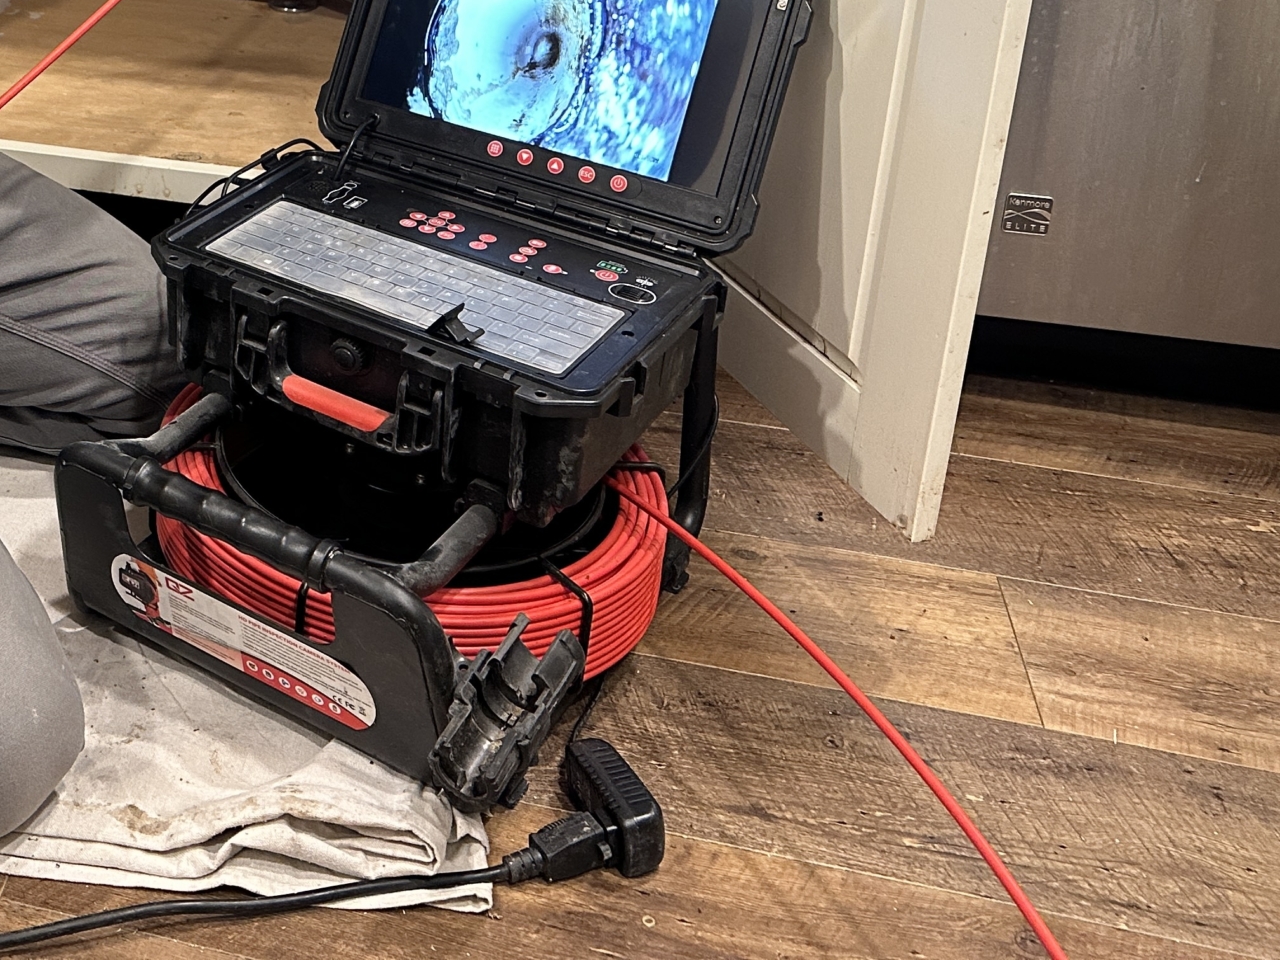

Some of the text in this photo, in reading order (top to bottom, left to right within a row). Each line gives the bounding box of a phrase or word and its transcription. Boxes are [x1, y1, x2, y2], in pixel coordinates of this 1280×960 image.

[581, 170, 593, 179] ESC
[1009, 197, 1051, 209] Kenmore
[1005, 221, 1046, 233] ELITE
[248, 620, 261, 630] PIPE
[260, 626, 298, 648] INSPECTION
[299, 645, 324, 661] CAMERA
